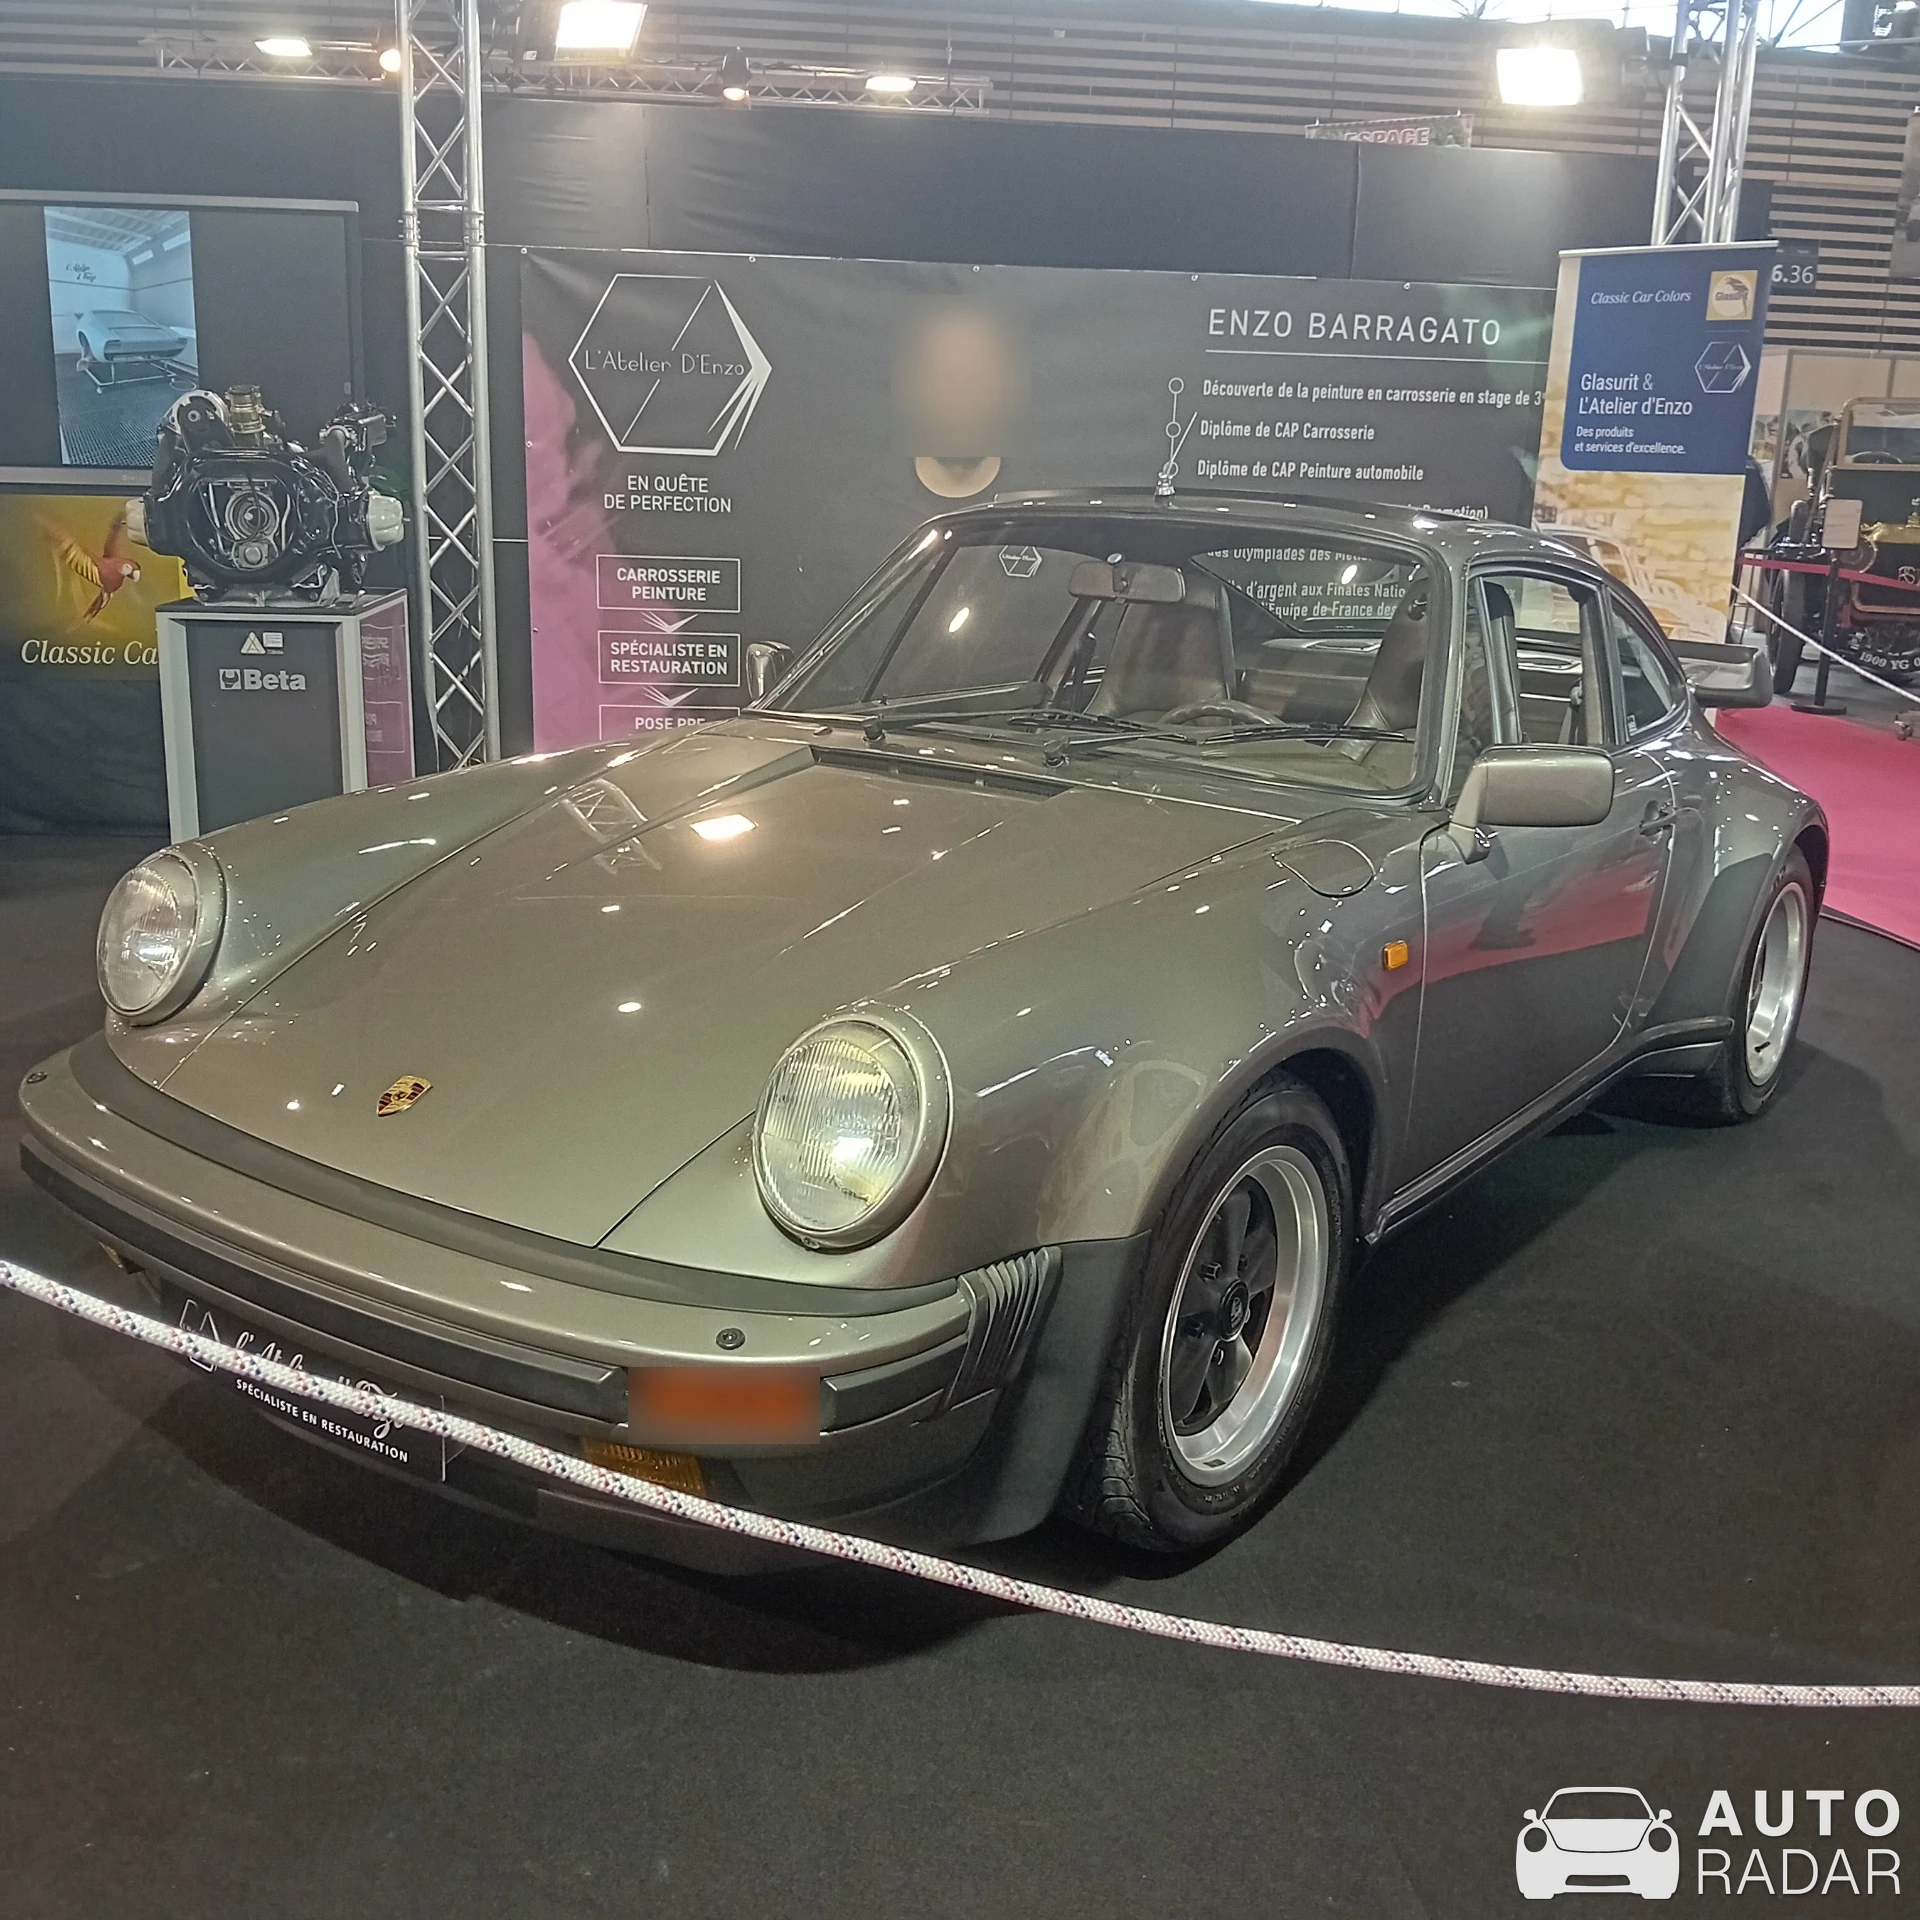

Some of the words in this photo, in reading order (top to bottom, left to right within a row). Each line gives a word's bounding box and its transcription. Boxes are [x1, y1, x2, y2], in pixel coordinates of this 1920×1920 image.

[1771, 264, 1814, 284] 6.36
[1590, 291, 1630, 304] Classic
[1632, 291, 1654, 303] Car
[1655, 290, 1692, 302] Colors
[1208, 309, 1293, 338] ENZO
[1307, 312, 1501, 346] BARRAGATO
[585, 350, 671, 372] L'Atelier
[681, 353, 745, 376] D'Enzo
[1581, 372, 1639, 391] Glasurit
[1642, 373, 1653, 391] &
[1203, 379, 1274, 397] Découverte
[1278, 381, 1293, 398] de
[1297, 382, 1309, 398] la
[1312, 383, 1364, 402] peinture
[1367, 388, 1382, 400] en
[1385, 387, 1455, 403] carrosserie
[1459, 391, 1474, 404] en
[1477, 389, 1511, 409] stage
[1515, 389, 1530, 405] de
[1578, 397, 1638, 415] L'Atelier
[1641, 397, 1693, 415] d'Enzo
[1200, 420, 1251, 440] Diplôme
[1255, 421, 1271, 437] de
[1275, 422, 1299, 438] CAP
[1303, 422, 1375, 440] Carrosserie
[1576, 426, 1593, 437] Des
[1595, 427, 1634, 439] produits
[1574, 442, 1584, 452] et
[1585, 442, 1624, 453] services
[1625, 442, 1686, 455] d'excellence.
[1197, 459, 1248, 480] Diplôme
[1252, 461, 1268, 477] de
[1271, 461, 1296, 478] CAP
[1299, 462, 1351, 479] Peinture
[1355, 464, 1424, 481] automobile
[627, 475, 649, 491] EN
[654, 473, 709, 493] QUÊTE
[604, 494, 626, 509] DE
[630, 495, 732, 513] PERFECTION
[616, 568, 721, 584] CARROSSERIE
[631, 586, 707, 601] PEINTURE
[1246, 581, 1297, 602] d'argent
[1301, 584, 1323, 596] aux
[1327, 582, 1370, 597] Finales
[1312, 601, 1327, 617] de
[1331, 601, 1373, 617] France
[21, 639, 115, 664] Classic
[124, 640, 158, 665] Ca
[610, 640, 704, 657] SPÉCIALISTE
[708, 644, 728, 658] EN
[610, 659, 728, 675] RESTAURATION
[243, 668, 306, 690] Beta
[635, 717, 674, 730] POSE
[236, 1379, 299, 1417] SPÉCIALISTE
[302, 1410, 317, 1425] EN
[321, 1419, 408, 1463] RESTAURATION
